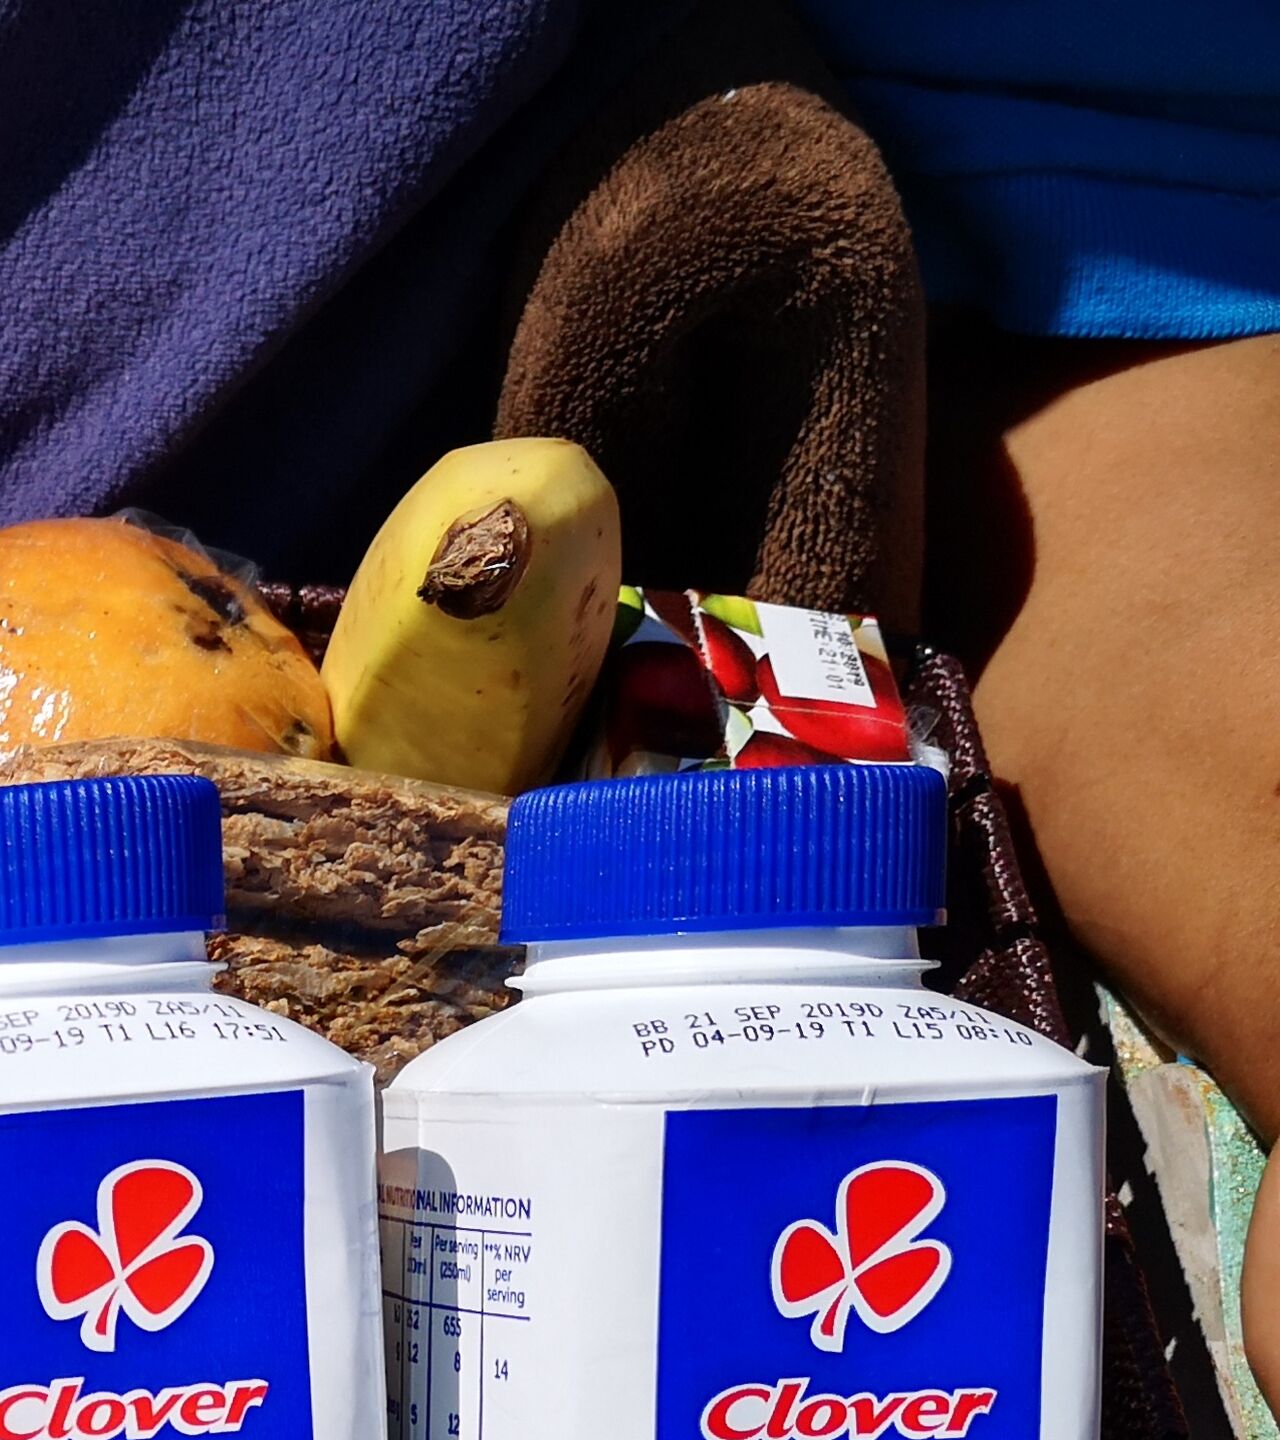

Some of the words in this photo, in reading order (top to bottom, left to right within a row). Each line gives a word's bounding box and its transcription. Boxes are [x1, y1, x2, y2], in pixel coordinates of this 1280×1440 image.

[103, 1023, 132, 1042] T1
[148, 1022, 196, 1041] L16
[213, 1022, 288, 1042] 17:51
[633, 1020, 668, 1038] BB
[685, 1011, 717, 1030] 21
[735, 1005, 781, 1023] SEP
[800, 1003, 884, 1019] 2019D
[642, 1039, 675, 1057] PD
[693, 1021, 825, 1049] 04-09-19
[842, 1020, 875, 1038] T1
[896, 1022, 943, 1040] L15
[957, 1023, 1033, 1047] 08:10
[439, 1193, 531, 1219] INFORMATION
[434, 1233, 447, 1252] Per
[447, 1238, 478, 1259] serving
[504, 1245, 531, 1264] NRV
[440, 1263, 471, 1284] (250ml)
[494, 1268, 512, 1286] per
[487, 1287, 525, 1308] serving
[443, 1315, 462, 1338] 655
[453, 1351, 461, 1373] 8
[494, 1359, 508, 1382] 14
[447, 1413, 460, 1437] 12
